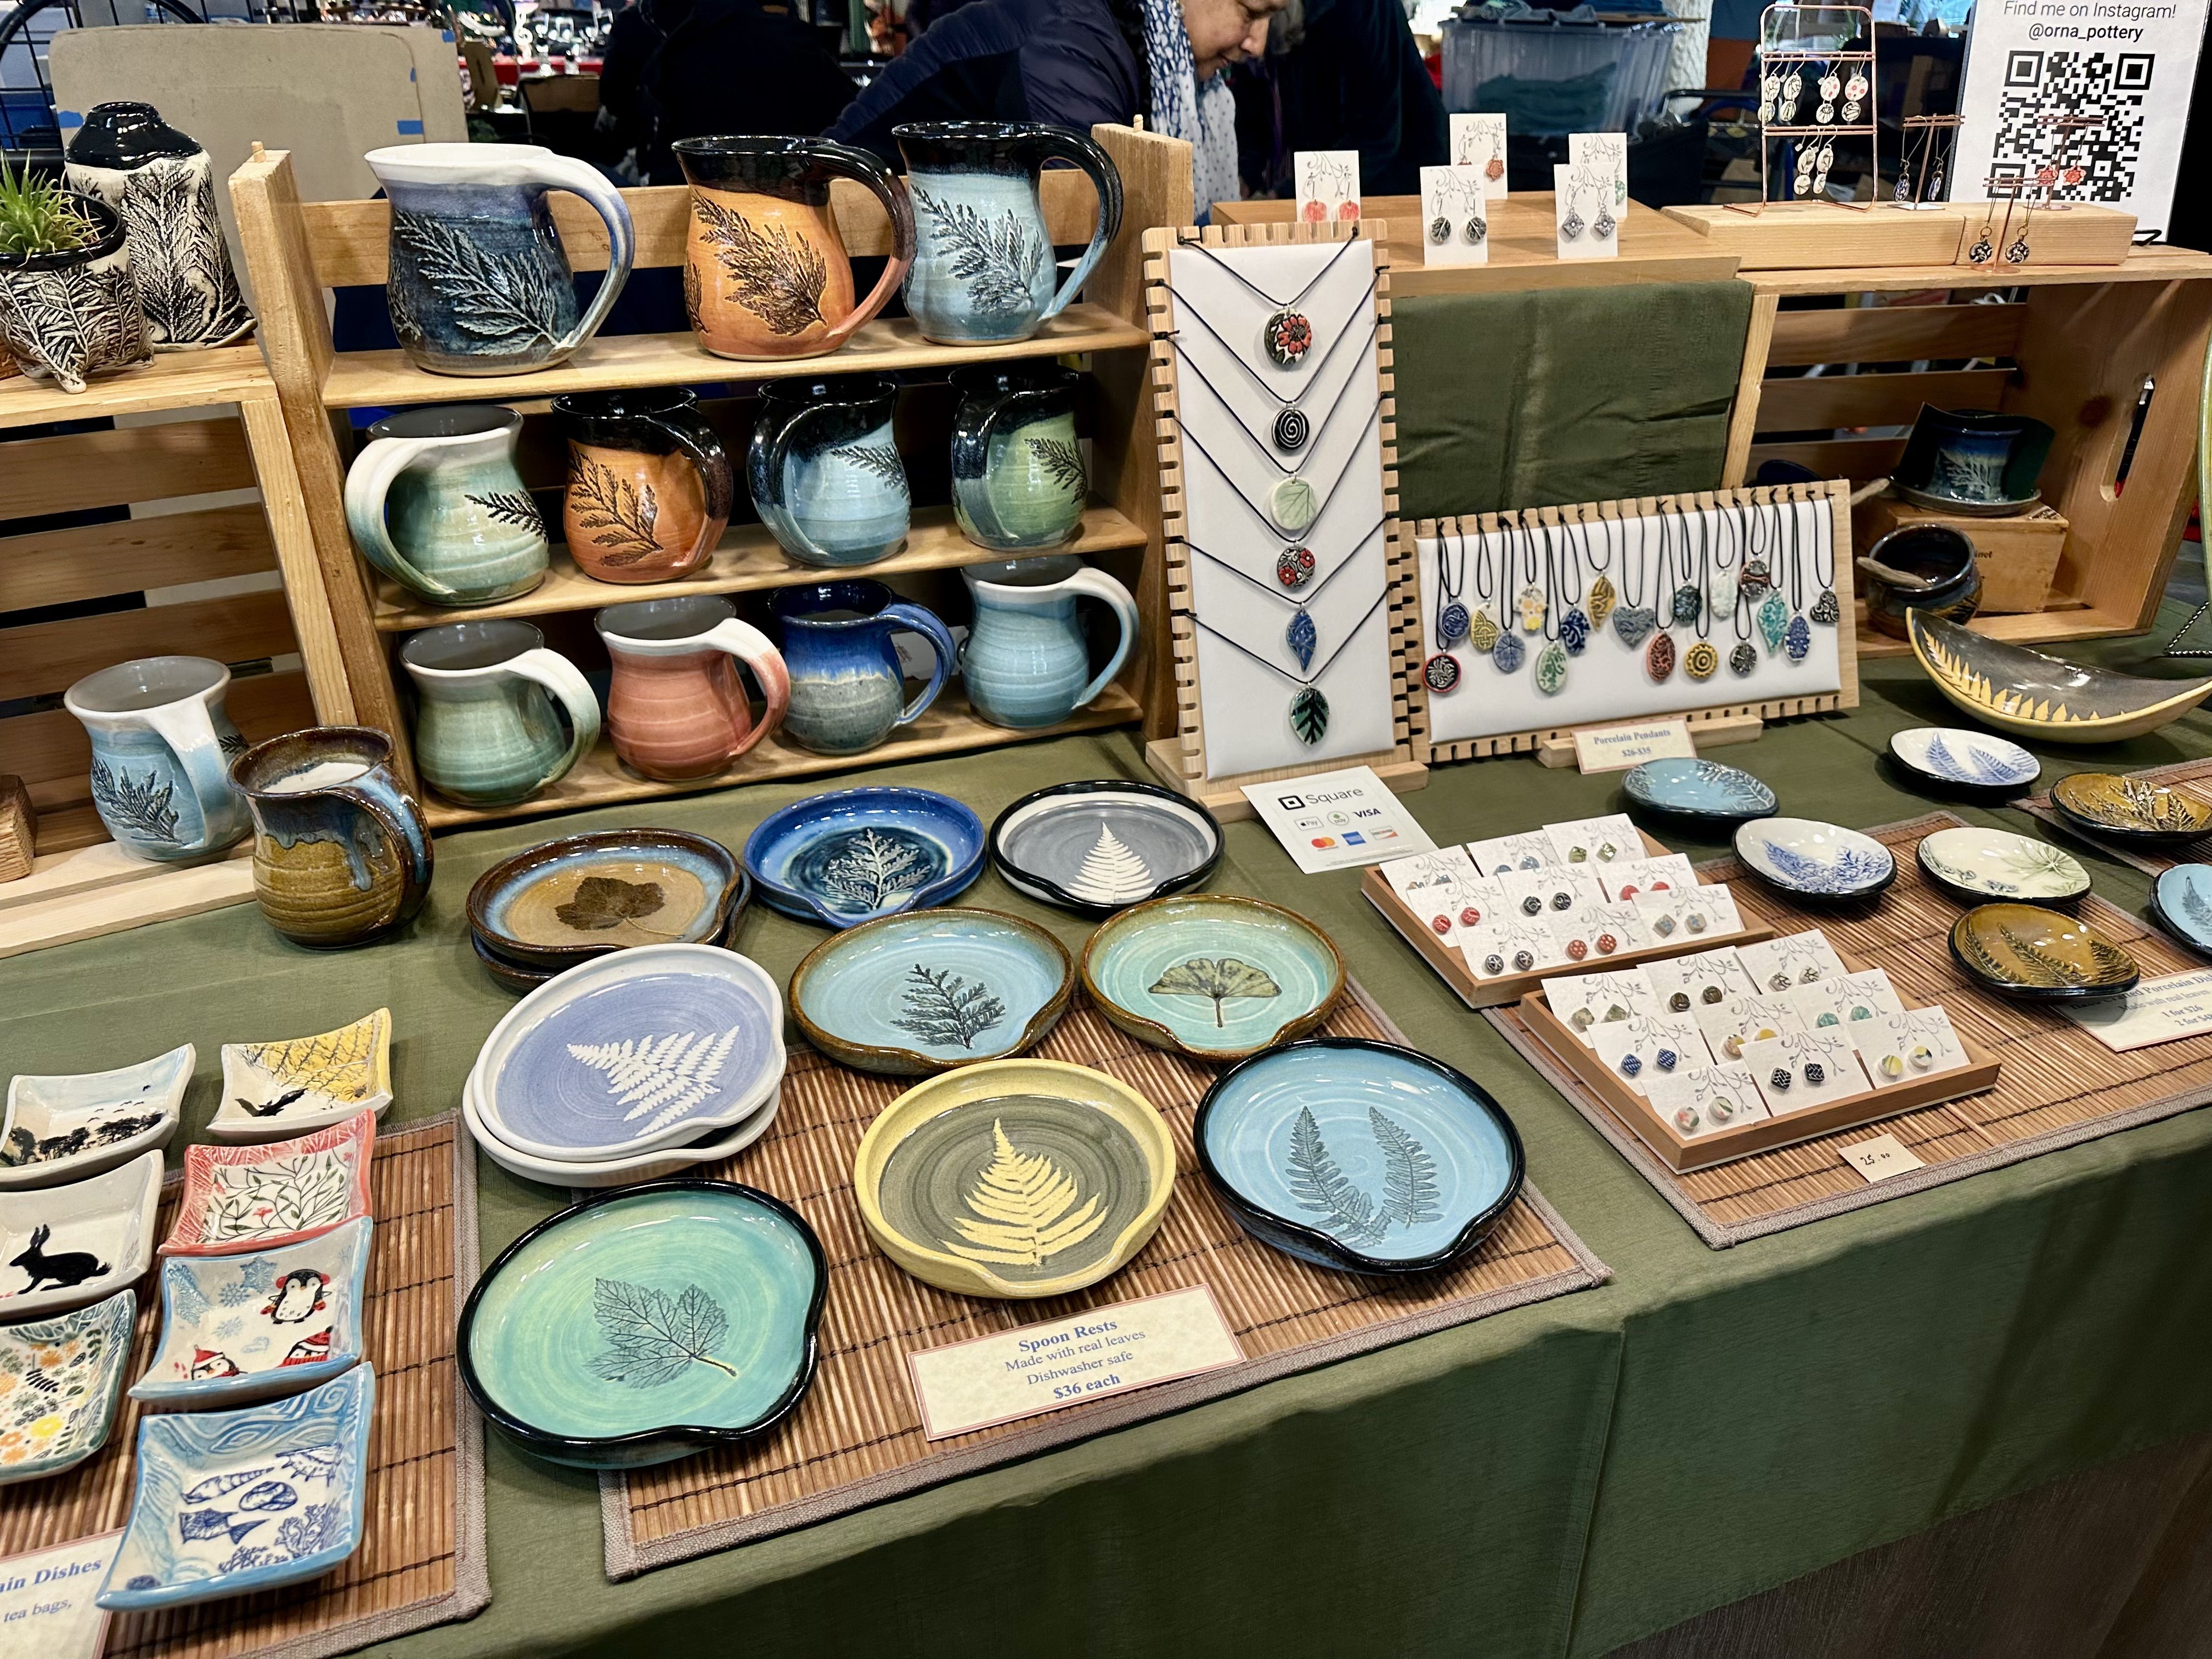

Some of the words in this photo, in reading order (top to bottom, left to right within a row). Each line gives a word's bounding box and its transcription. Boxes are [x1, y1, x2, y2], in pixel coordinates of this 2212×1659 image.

[2004, 1, 2036, 16] Find
[2041, 4, 2065, 16] me
[2070, 5, 2089, 16] on
[2094, 3, 2176, 21] Instagram!
[2029, 23, 2144, 42] @orna_pottery
[1594, 734, 1632, 745] Porcelain
[1634, 729, 1671, 740] Pendants
[1622, 747, 1651, 757] $26-$35
[1306, 789, 1363, 804] Square
[1353, 808, 1381, 817] VISA
[2142, 980, 2194, 994] Porcelain
[2118, 1002, 2146, 1011] Made
[2180, 990, 2210, 998] leaves
[1019, 1333, 1070, 1353] Spoon
[1073, 1321, 1118, 1338] Rests
[1005, 1356, 1043, 1372] Made
[1046, 1347, 1075, 1361] with
[1078, 1339, 1103, 1353] real
[1105, 1331, 1146, 1346] leaves
[1026, 1359, 1104, 1385] Dishwasher
[1107, 1351, 1133, 1365] safe
[1053, 1382, 1082, 1399] $36
[1086, 1374, 1121, 1391] each
[33, 1560, 101, 1584] Dishes
[4, 1609, 26, 1623] tea
[32, 1599, 72, 1615] bags,
